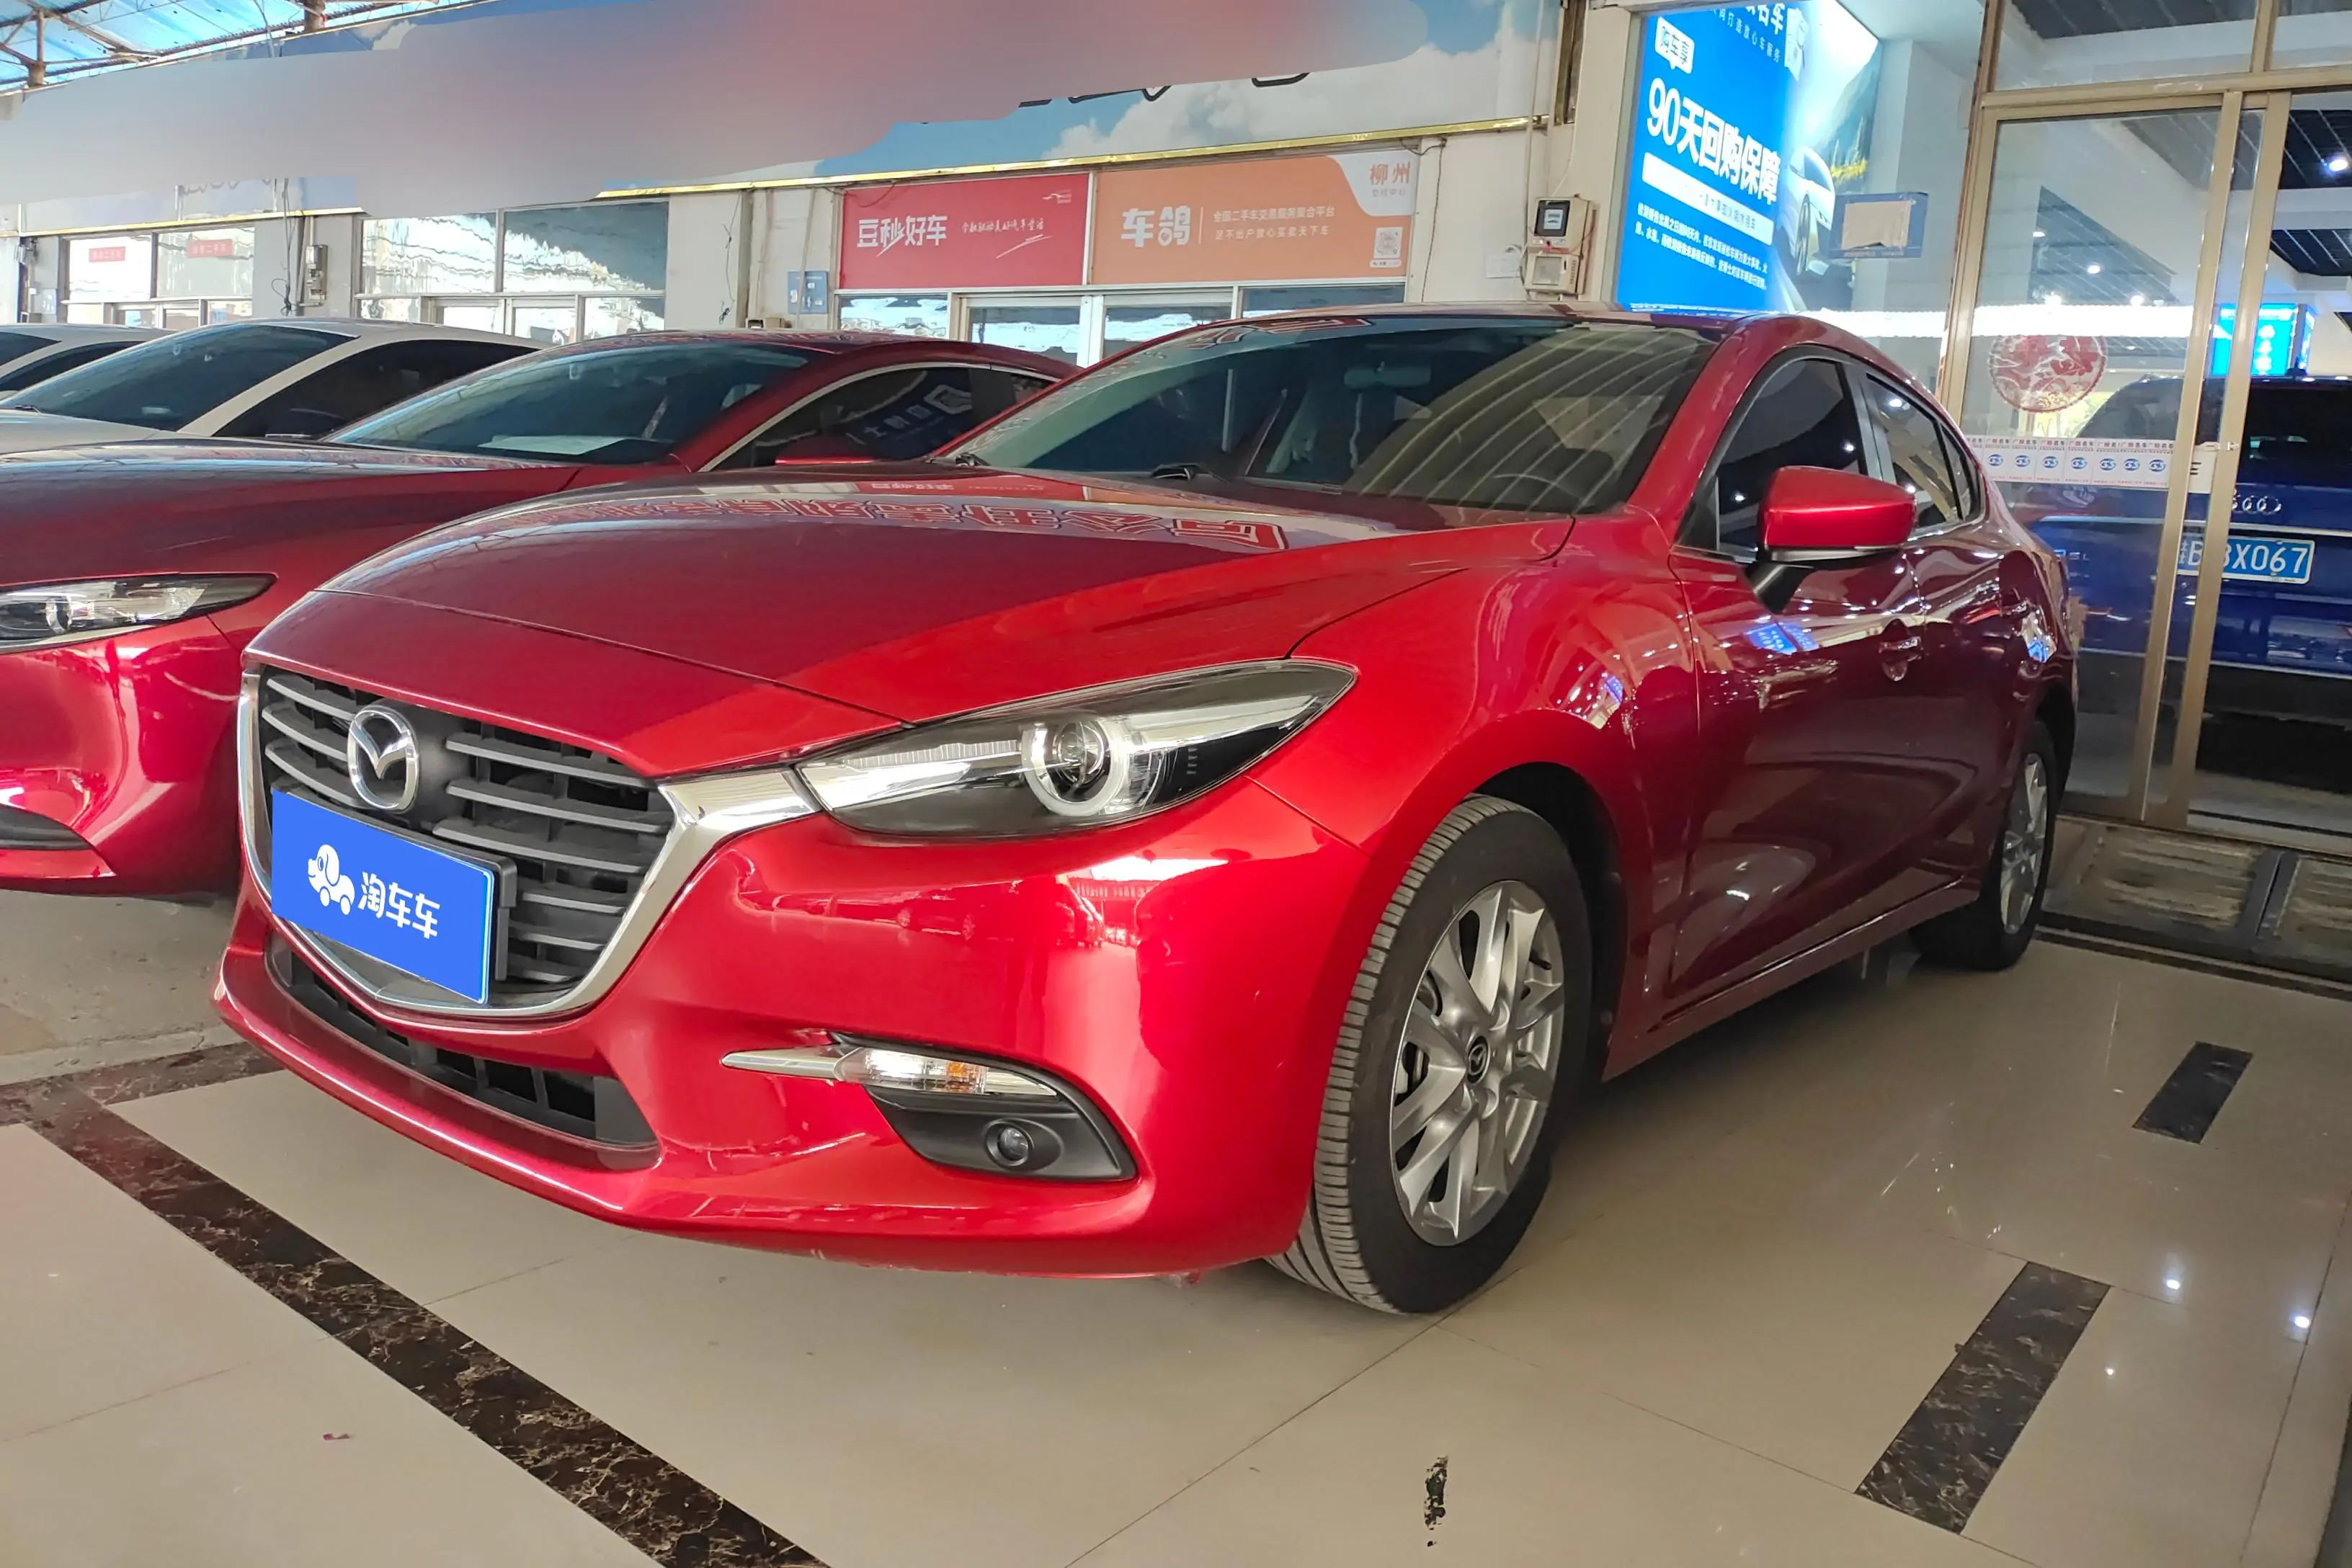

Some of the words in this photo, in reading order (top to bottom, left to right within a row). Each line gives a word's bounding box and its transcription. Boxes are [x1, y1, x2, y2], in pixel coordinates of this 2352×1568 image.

[1647, 78, 1781, 205] 90天回购保障
[1369, 161, 1411, 185] 柳州
[857, 215, 948, 257] 豆秒好车
